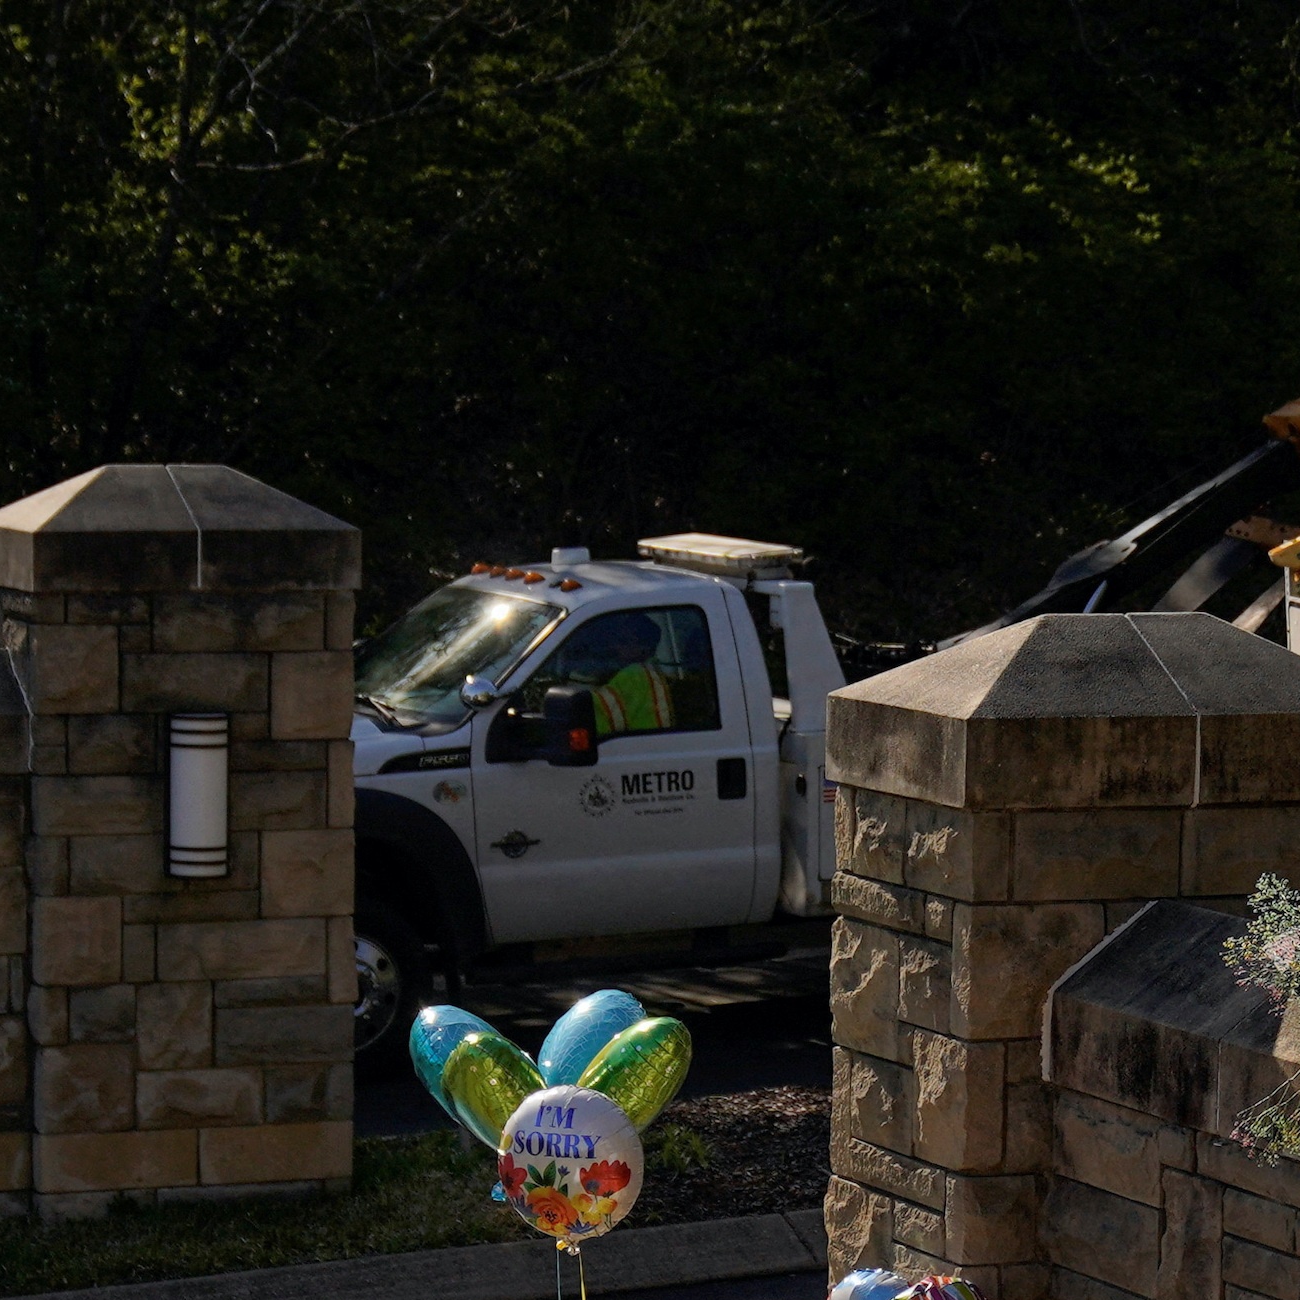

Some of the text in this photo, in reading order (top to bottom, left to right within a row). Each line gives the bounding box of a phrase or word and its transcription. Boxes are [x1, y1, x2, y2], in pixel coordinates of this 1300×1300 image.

[620, 770, 695, 796] METRO
[534, 1105, 578, 1130] I'M
[513, 1129, 602, 1159] SORRY
